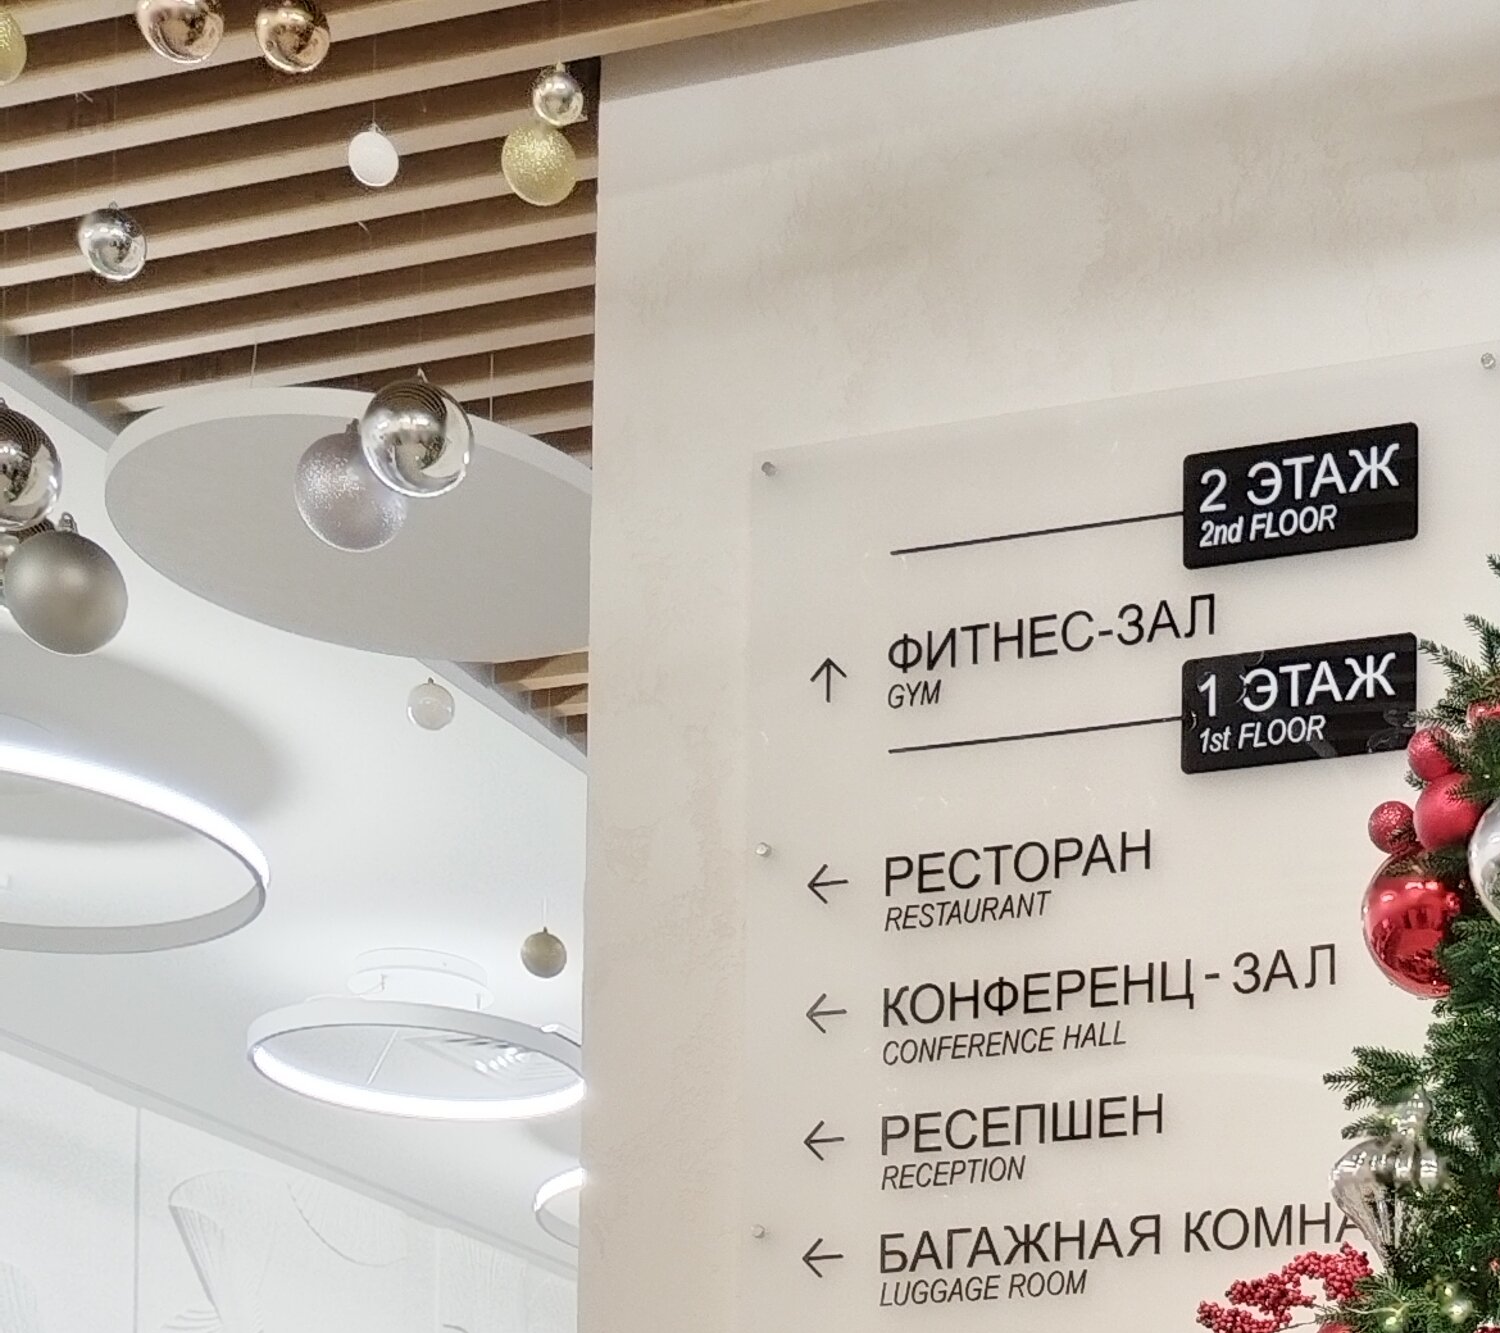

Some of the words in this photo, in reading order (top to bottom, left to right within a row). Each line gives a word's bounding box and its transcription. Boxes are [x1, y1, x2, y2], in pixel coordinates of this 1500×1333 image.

[1199, 468, 1227, 513] 2
[1245, 443, 1400, 505] ЭТАЖ
[1199, 515, 1244, 548] 2nd
[1249, 501, 1338, 541] FLOOR
[888, 594, 1217, 673] ФИТНЕС-ЗАЛ
[887, 679, 942, 710] GYM
[1197, 674, 1216, 717] 1
[1243, 653, 1396, 712] ЭТАЖ
[1199, 726, 1232, 753] 1st
[1238, 714, 1326, 750] FLOOR
[885, 828, 1151, 899] РЕСТОРАН
[884, 888, 1052, 932] RESTAURANT
[883, 1026, 1056, 1066] CONFERENCE
[1063, 1020, 1126, 1050] HALL
[881, 1093, 1163, 1156] РЕСЕПШЕН
[881, 1154, 1026, 1191] RECEPTION
[880, 1214, 1161, 1275] БАГАЖНАЯ
[879, 1278, 999, 1307] LUGGAGE
[1008, 1268, 1088, 1299] ROOM
